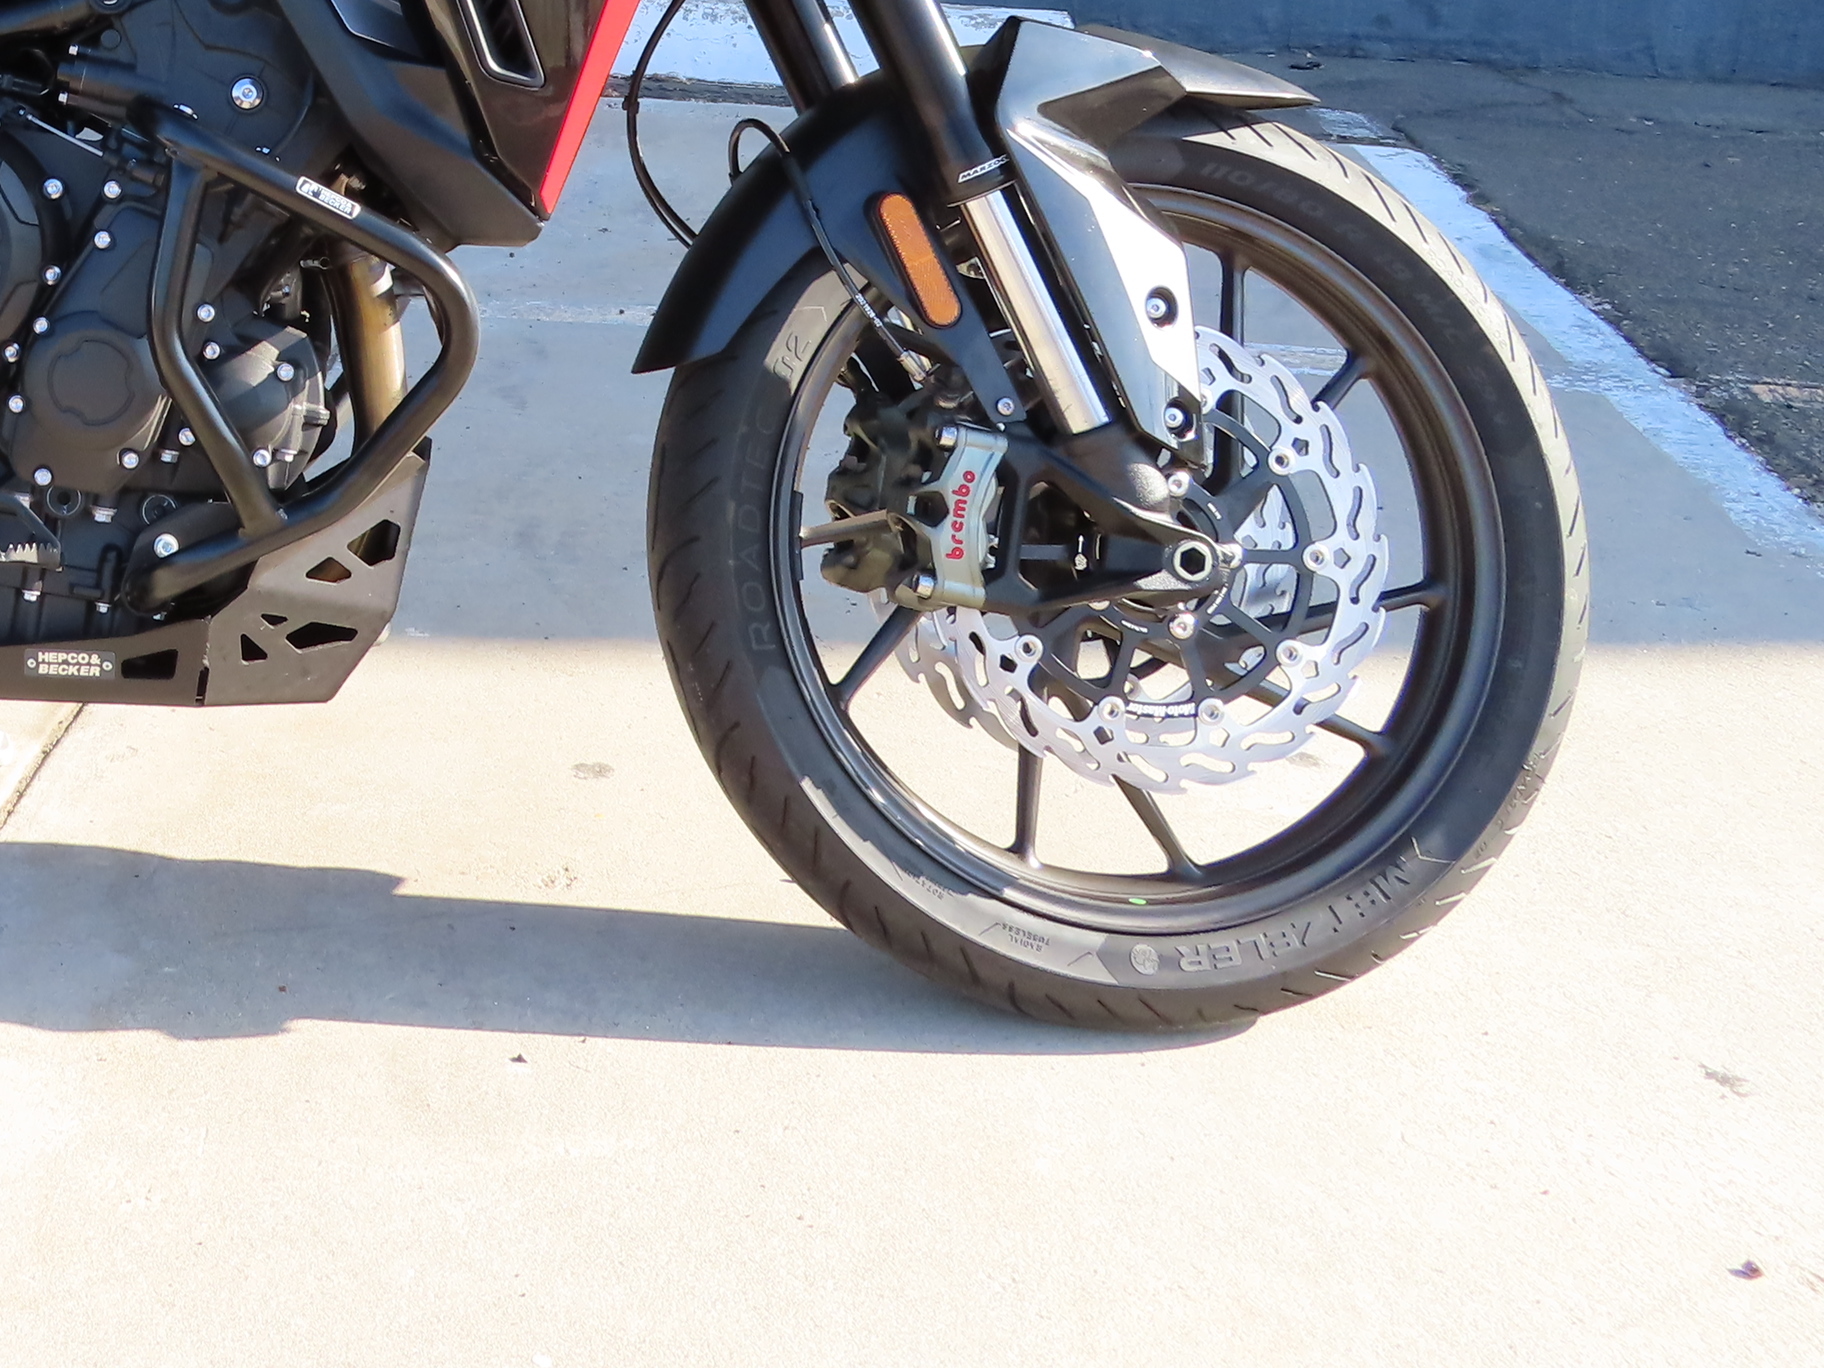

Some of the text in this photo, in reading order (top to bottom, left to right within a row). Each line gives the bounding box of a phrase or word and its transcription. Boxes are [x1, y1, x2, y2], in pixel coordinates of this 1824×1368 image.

[738, 406, 776, 660] ROADTEC
[946, 470, 976, 560] brembo
[38, 664, 101, 677] BECKER
